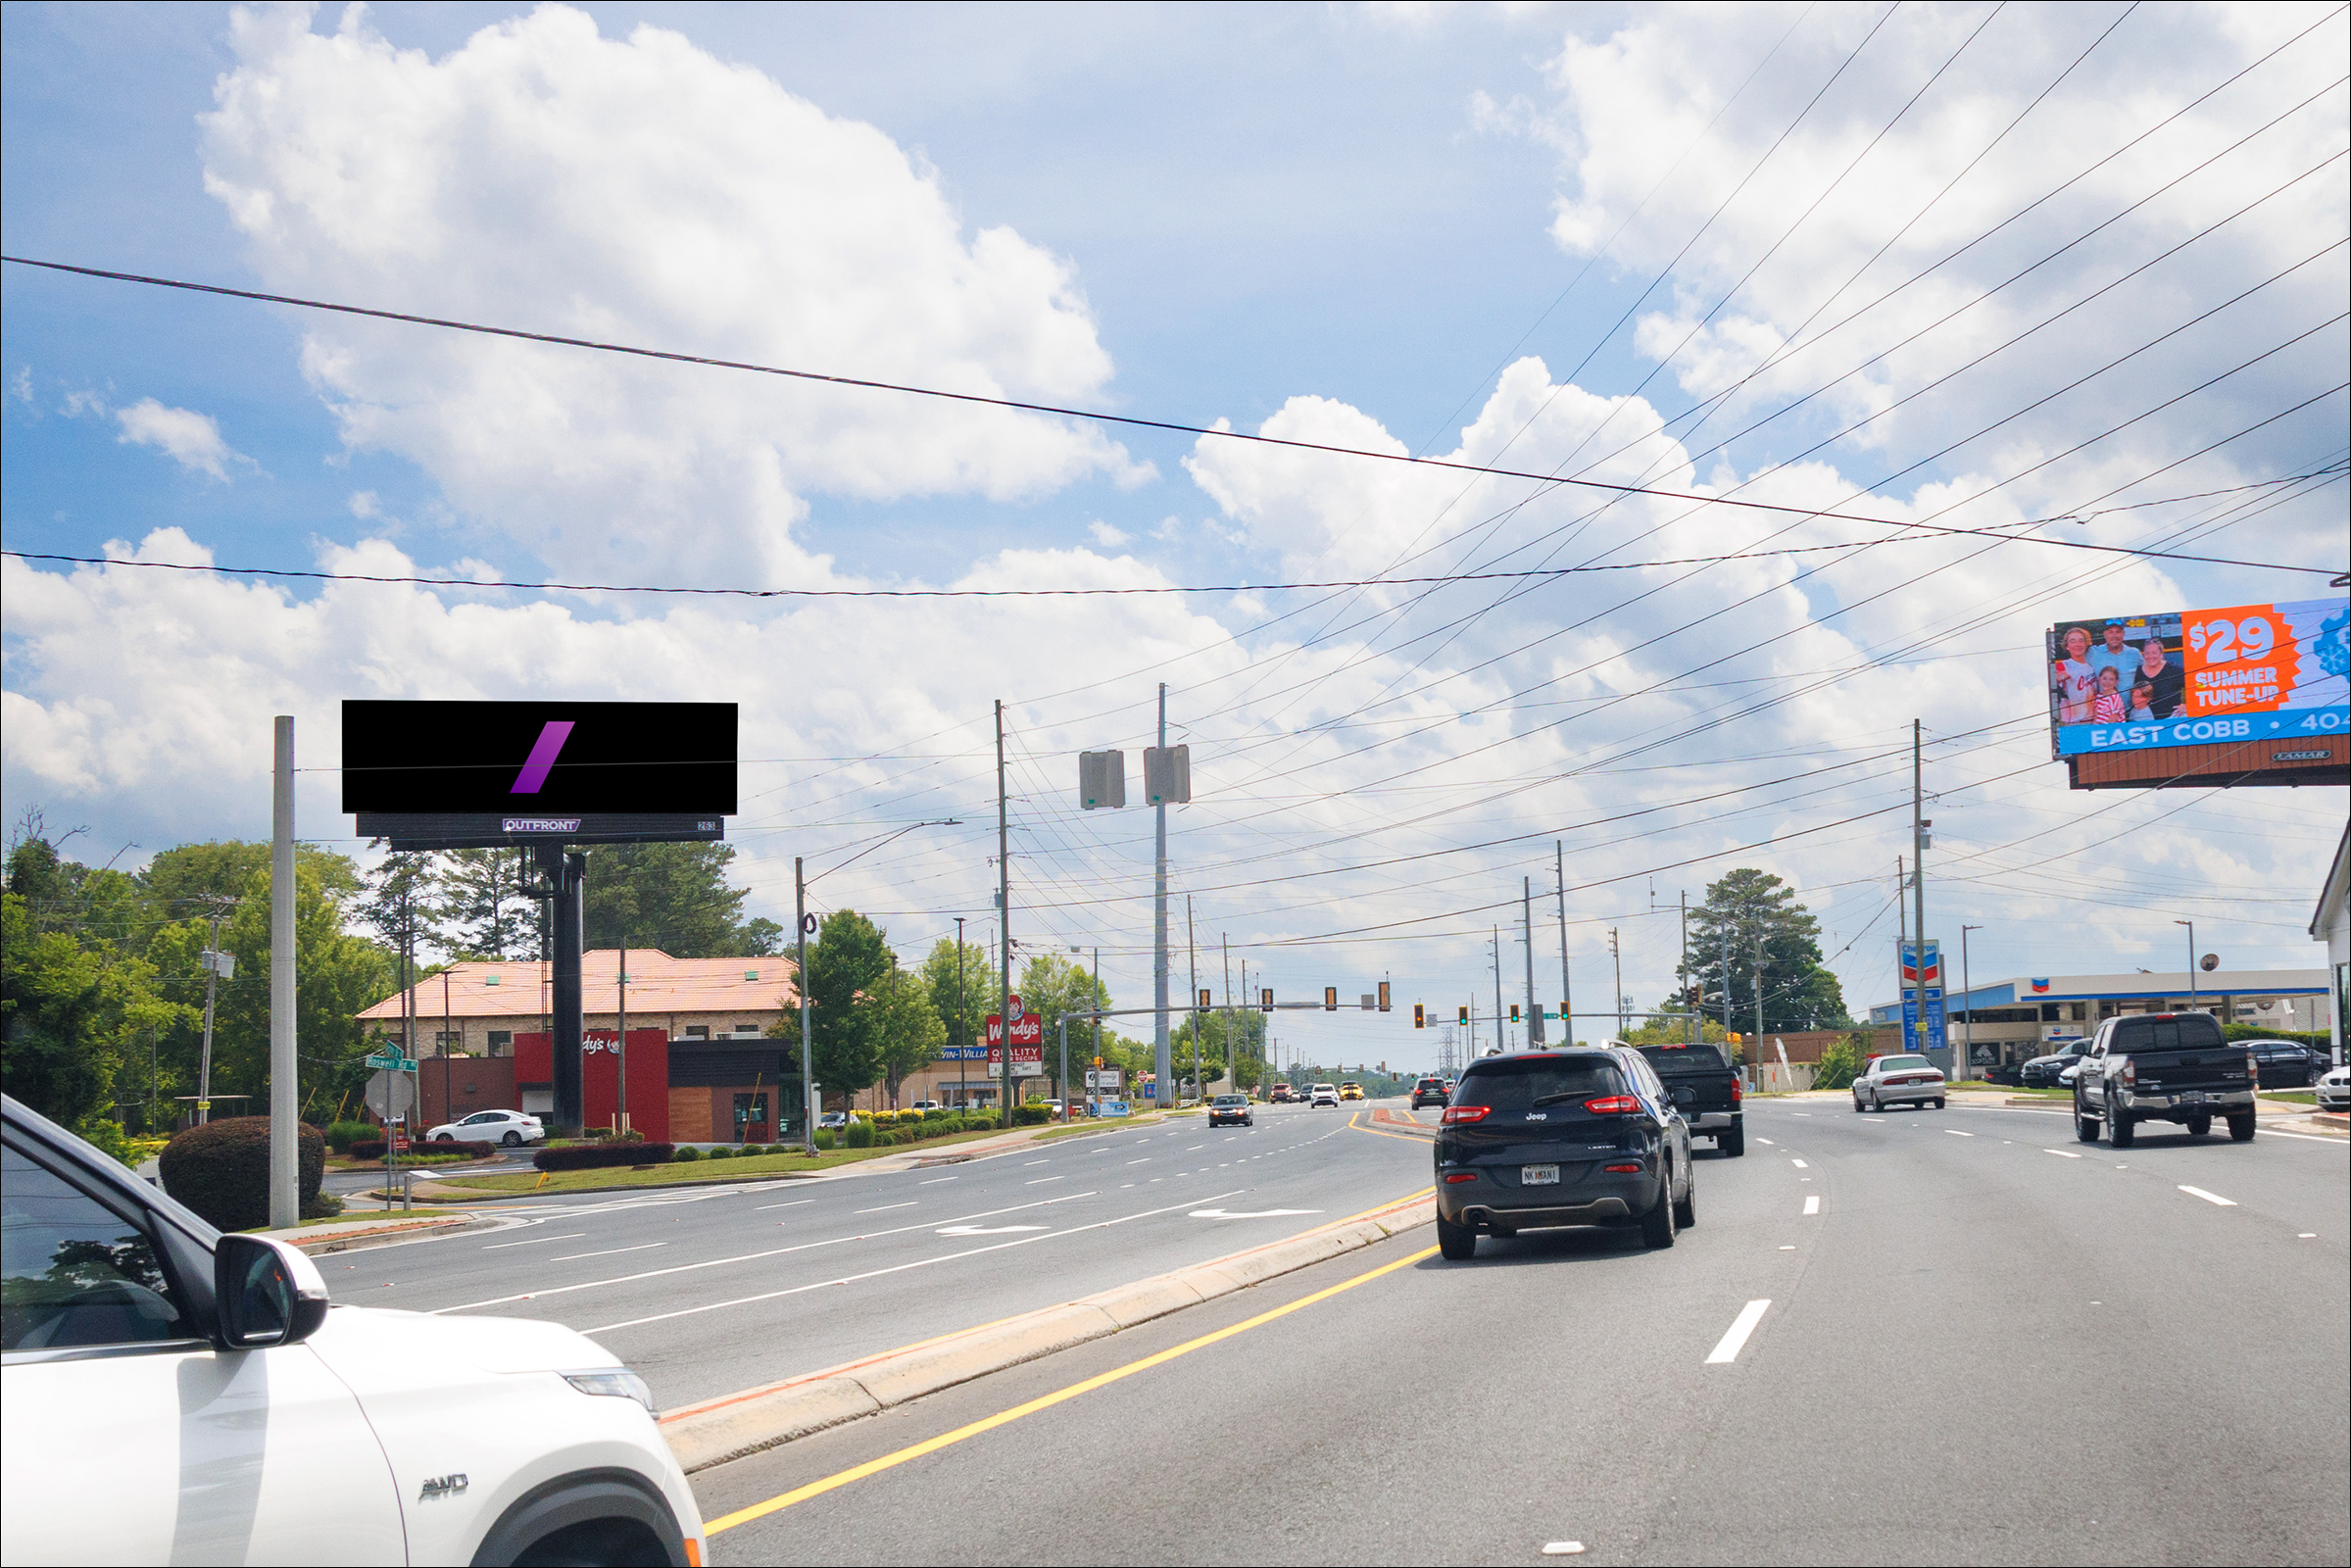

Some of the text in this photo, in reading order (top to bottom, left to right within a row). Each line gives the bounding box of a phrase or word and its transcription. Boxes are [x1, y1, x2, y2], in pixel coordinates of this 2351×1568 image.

[2189, 615, 2275, 663] $29
[2194, 666, 2278, 688] SUMMER
[2194, 685, 2279, 707] TUNE-UP
[2090, 723, 2163, 748] EAST
[2173, 719, 2250, 742] COBB
[2277, 751, 2326, 760] LAMAR
[506, 820, 576, 830] OUTFRONT
[989, 1019, 1039, 1041] Wndy's
[367, 1056, 395, 1068] Roswell
[418, 1474, 468, 1500] AWD
